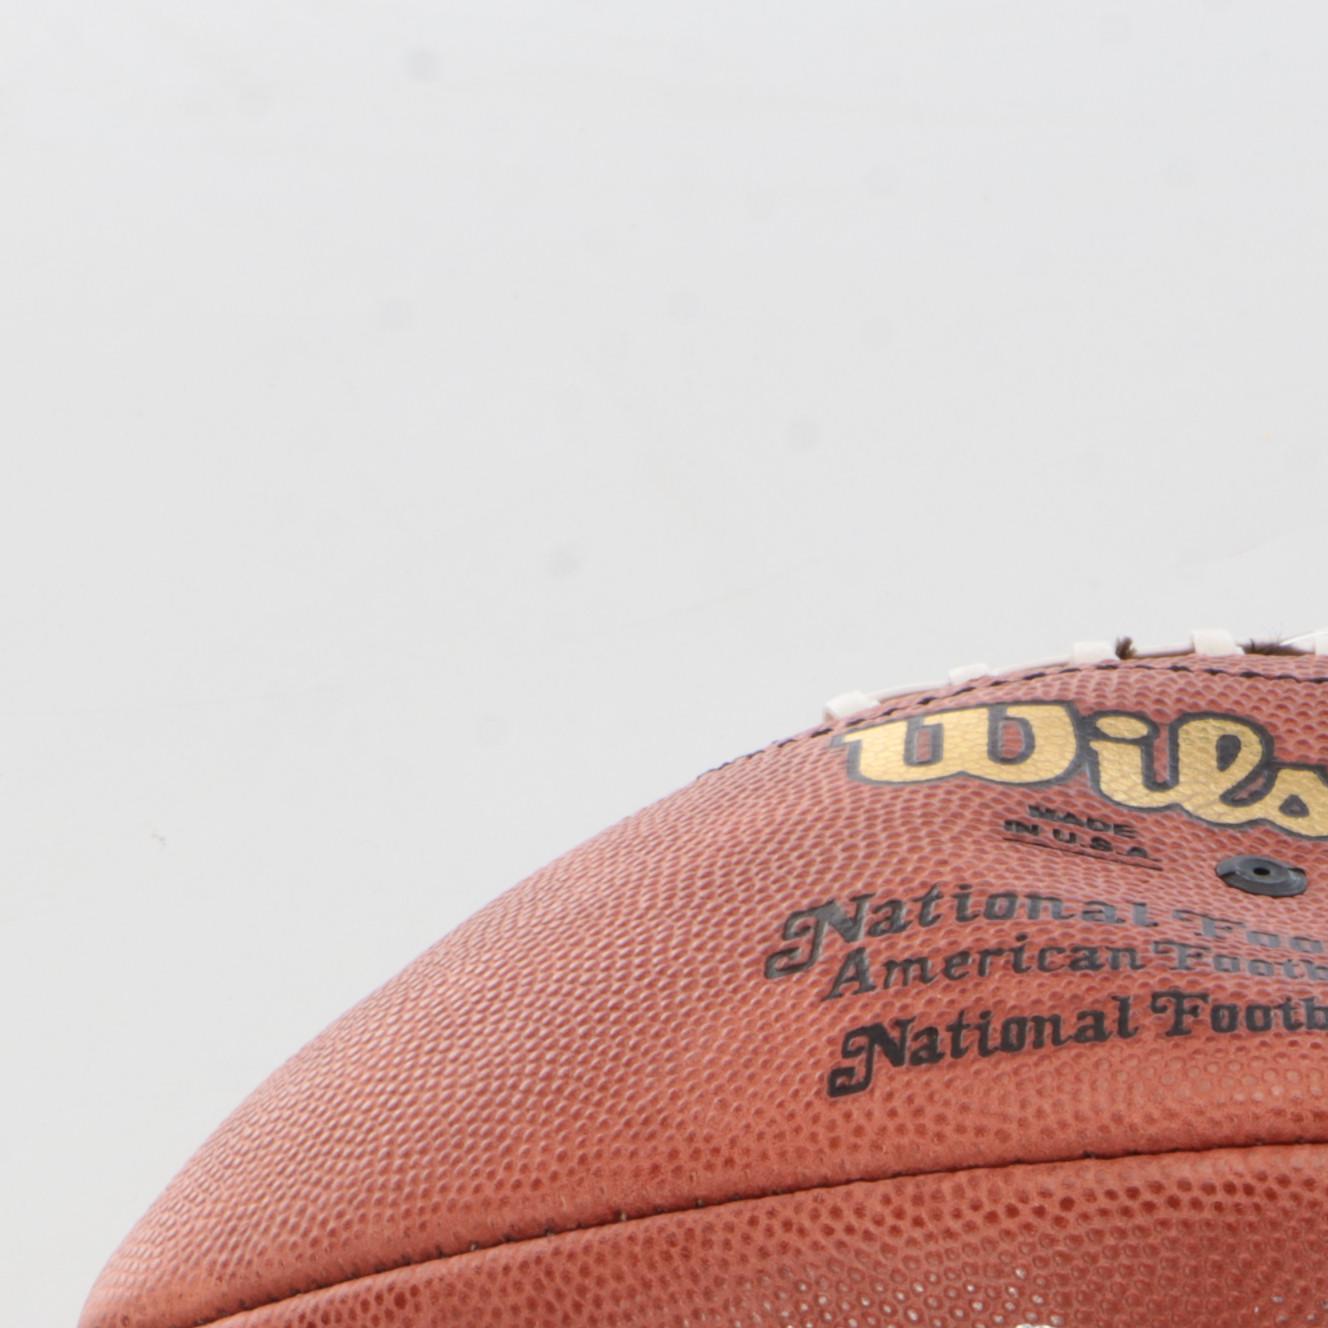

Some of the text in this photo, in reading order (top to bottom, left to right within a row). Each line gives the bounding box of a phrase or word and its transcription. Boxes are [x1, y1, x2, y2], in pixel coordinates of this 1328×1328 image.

[1003, 819, 1041, 837] IN
[1028, 804, 1138, 839] MADE
[763, 882, 1160, 980] National
[821, 933, 1146, 1001] American
[826, 994, 1139, 1099] National
